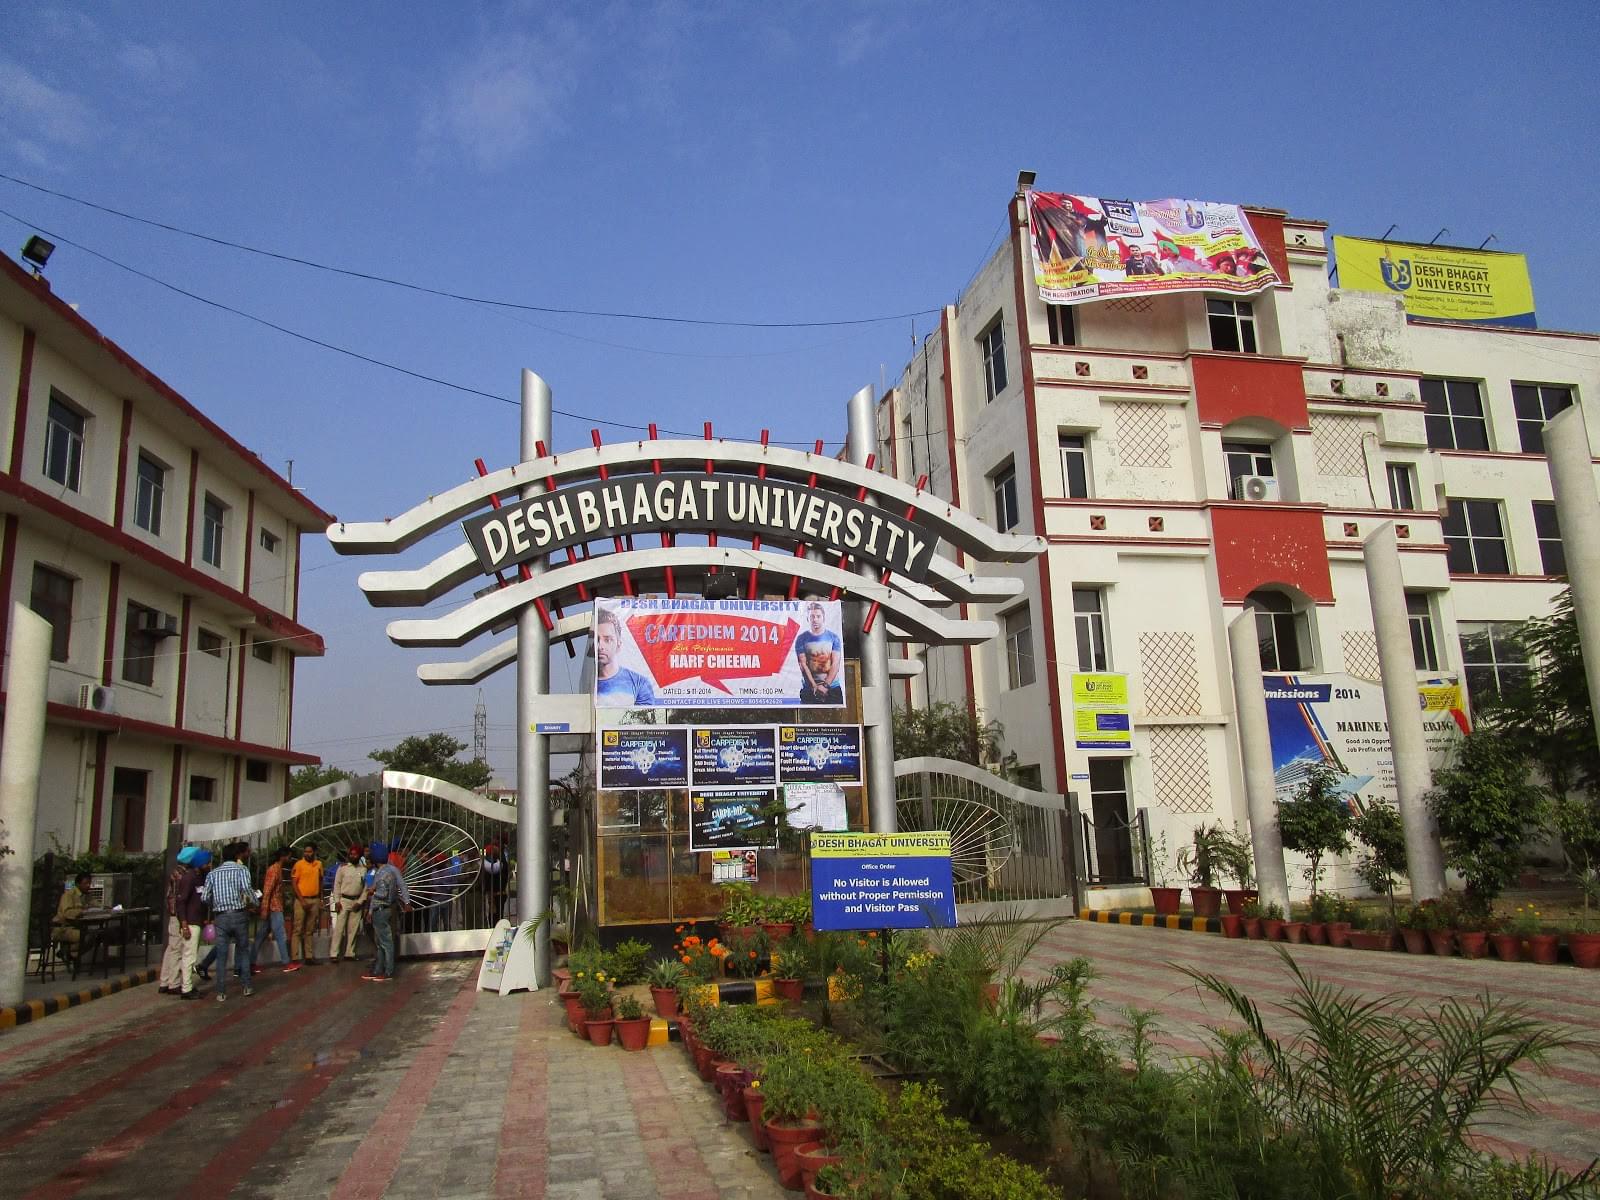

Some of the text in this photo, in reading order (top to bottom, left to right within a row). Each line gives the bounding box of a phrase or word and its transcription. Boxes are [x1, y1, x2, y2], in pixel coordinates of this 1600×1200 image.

[1414, 264, 1489, 283] DESH BHAGAT
[1053, 287, 1095, 298] REGISTRATION
[1416, 277, 1491, 294] UNIVERSITY
[483, 480, 925, 574] DESH BHAGAT UNIVERSITY
[661, 599, 716, 611] BHAGAT
[719, 600, 801, 613] UNIVERSITY
[645, 623, 779, 646] CARTEDIEM 2014
[670, 653, 761, 669] HARF CHEEMA
[1335, 688, 1361, 700] 2014
[1335, 721, 1383, 732] MARINE
[818, 837, 951, 849] DESH BHAGAT UNIVERSITY
[833, 877, 929, 888] No Visitor is Allowed
[819, 889, 944, 904] without Proper Permission
[844, 903, 920, 913] and Visitor Pass
